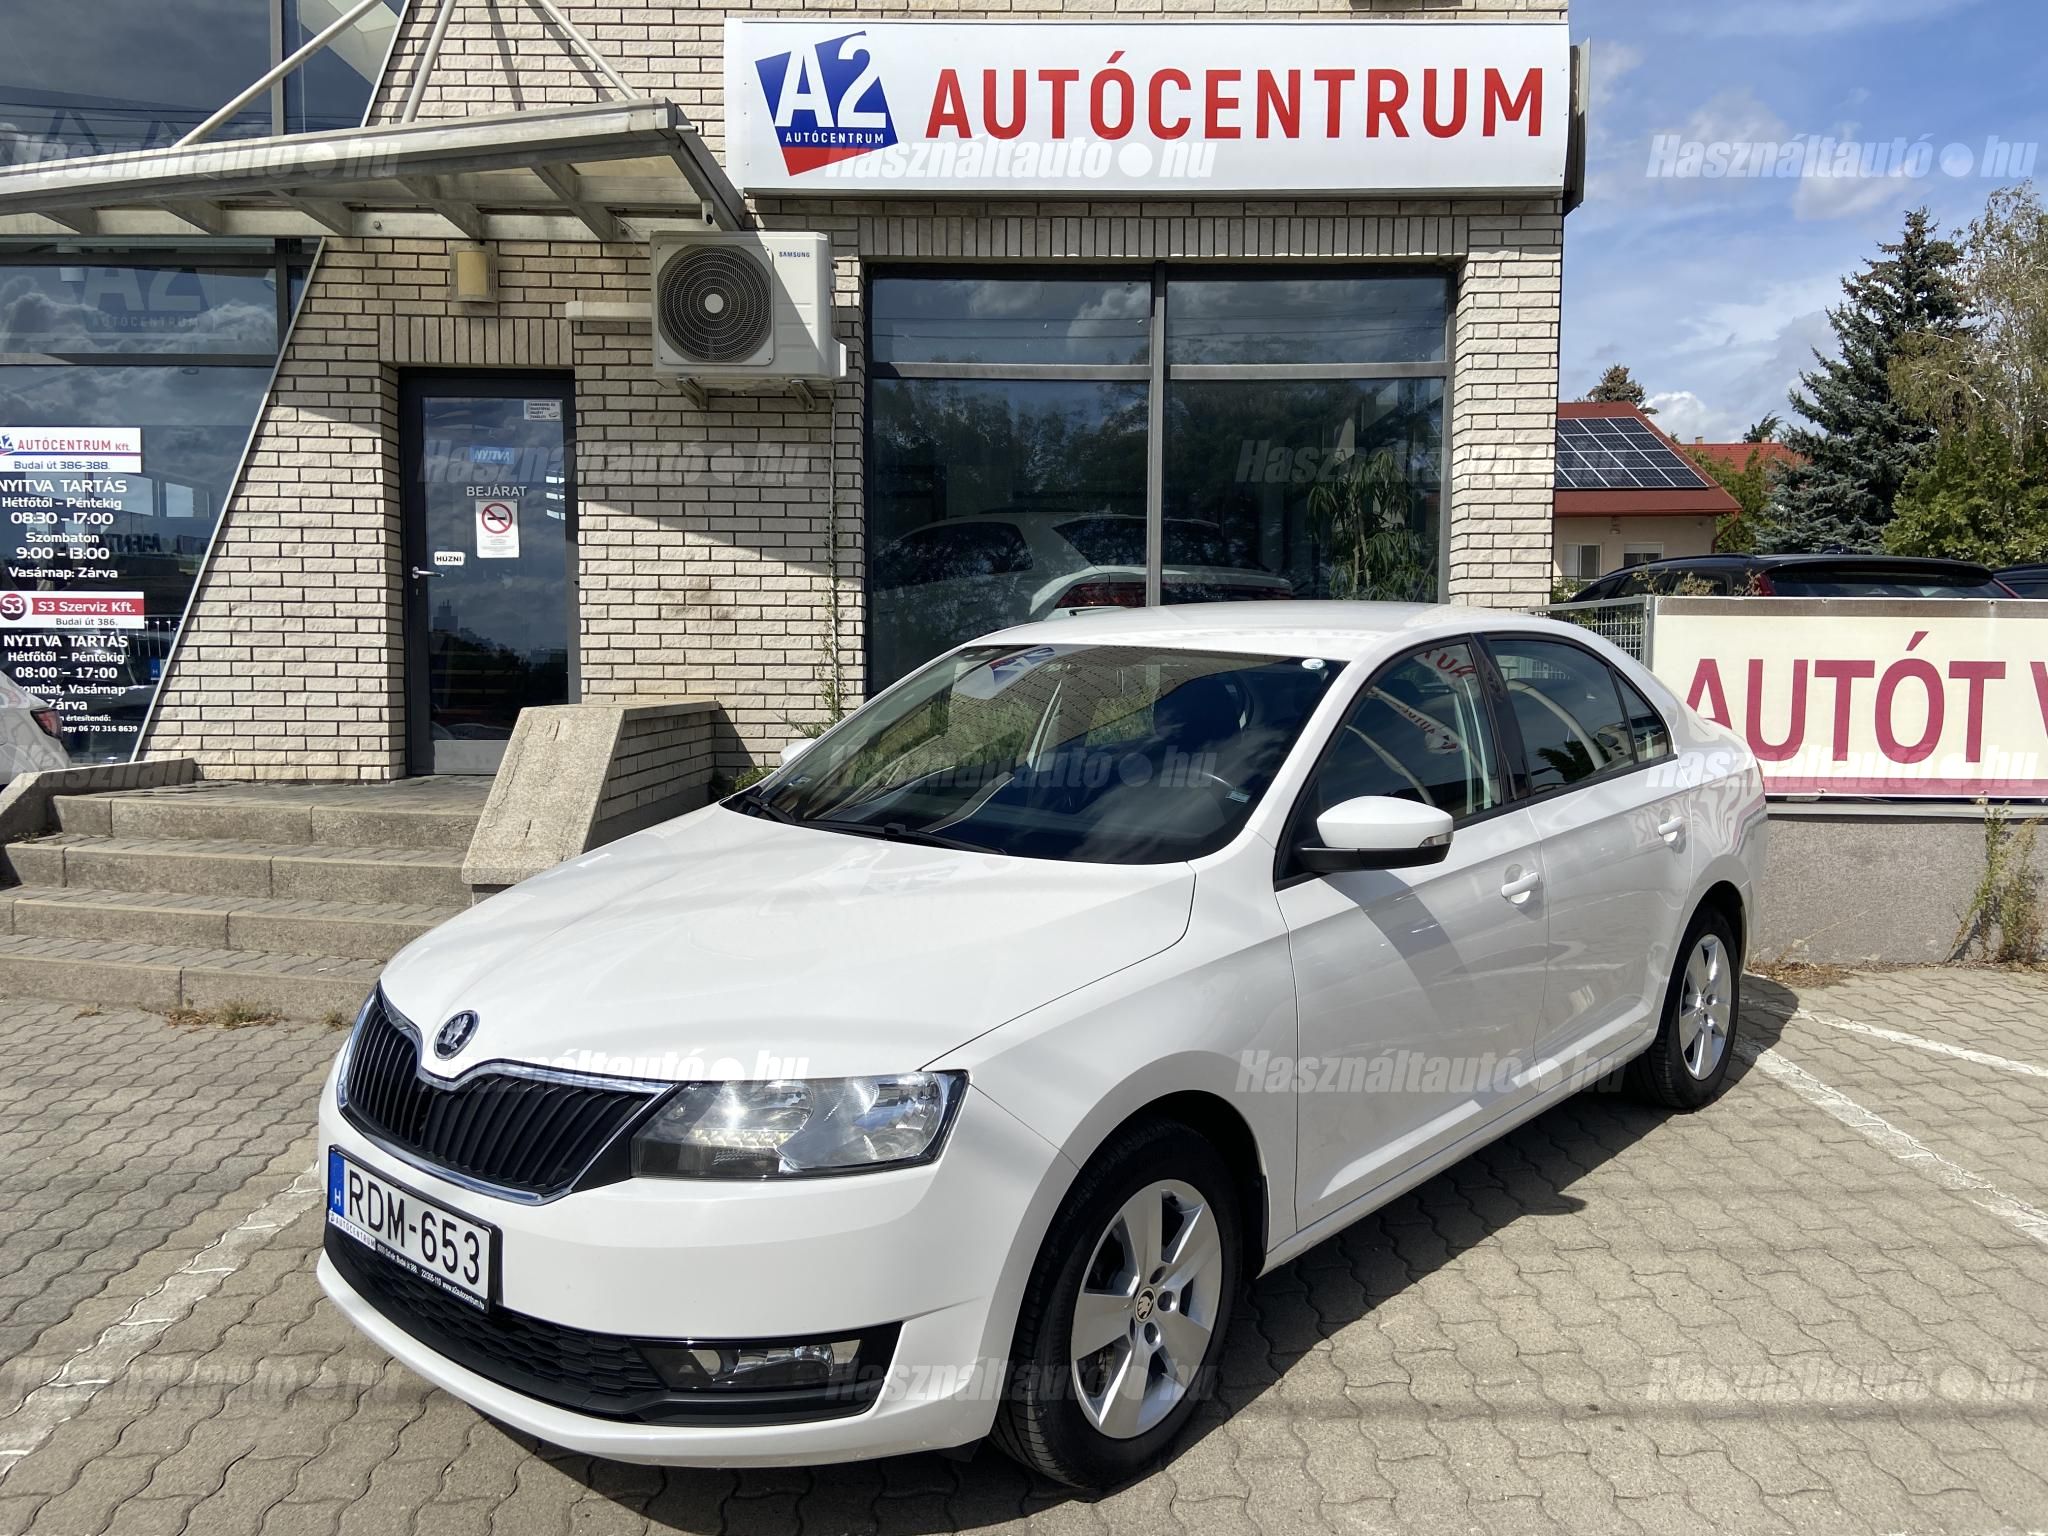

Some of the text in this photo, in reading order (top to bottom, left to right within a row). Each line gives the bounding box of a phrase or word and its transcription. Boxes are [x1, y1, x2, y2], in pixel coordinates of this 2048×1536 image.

[774, 34, 887, 128] A2
[925, 51, 1544, 139] AUTÓCENTRUM
[785, 130, 884, 144] AUTÓCENTRUM
[14, 461, 44, 470] Budai
[46, 461, 57, 470] út
[0, 477, 127, 493] NYITVA TARTÁS
[466, 483, 527, 497] BEJÁRAT
[2, 496, 53, 508] Hétfőtől
[66, 497, 122, 511] Péntekig
[11, 512, 57, 525] 08:30
[73, 512, 114, 525] 17:00
[25, 531, 100, 543] Szombaton
[16, 547, 53, 560] 9:00
[69, 547, 110, 560] 13:00
[8, 566, 118, 580] Vasárnap: Zárva
[38, 601, 136, 613] S3 Szerviz Kft.
[56, 617, 118, 626] Budai út 386.
[3, 632, 128, 647] NYITVA TARTÁS
[7, 652, 57, 662] Hétfőtől
[71, 652, 125, 665] Péntekig
[15, 667, 57, 679] 08:00
[76, 667, 118, 679] 17:00
[20, 683, 126, 696] ombat, Vasárnap
[46, 698, 88, 710] Zárva
[1686, 631, 2007, 764] AUTÓT
[333, 1168, 480, 1286] H RDM-653
